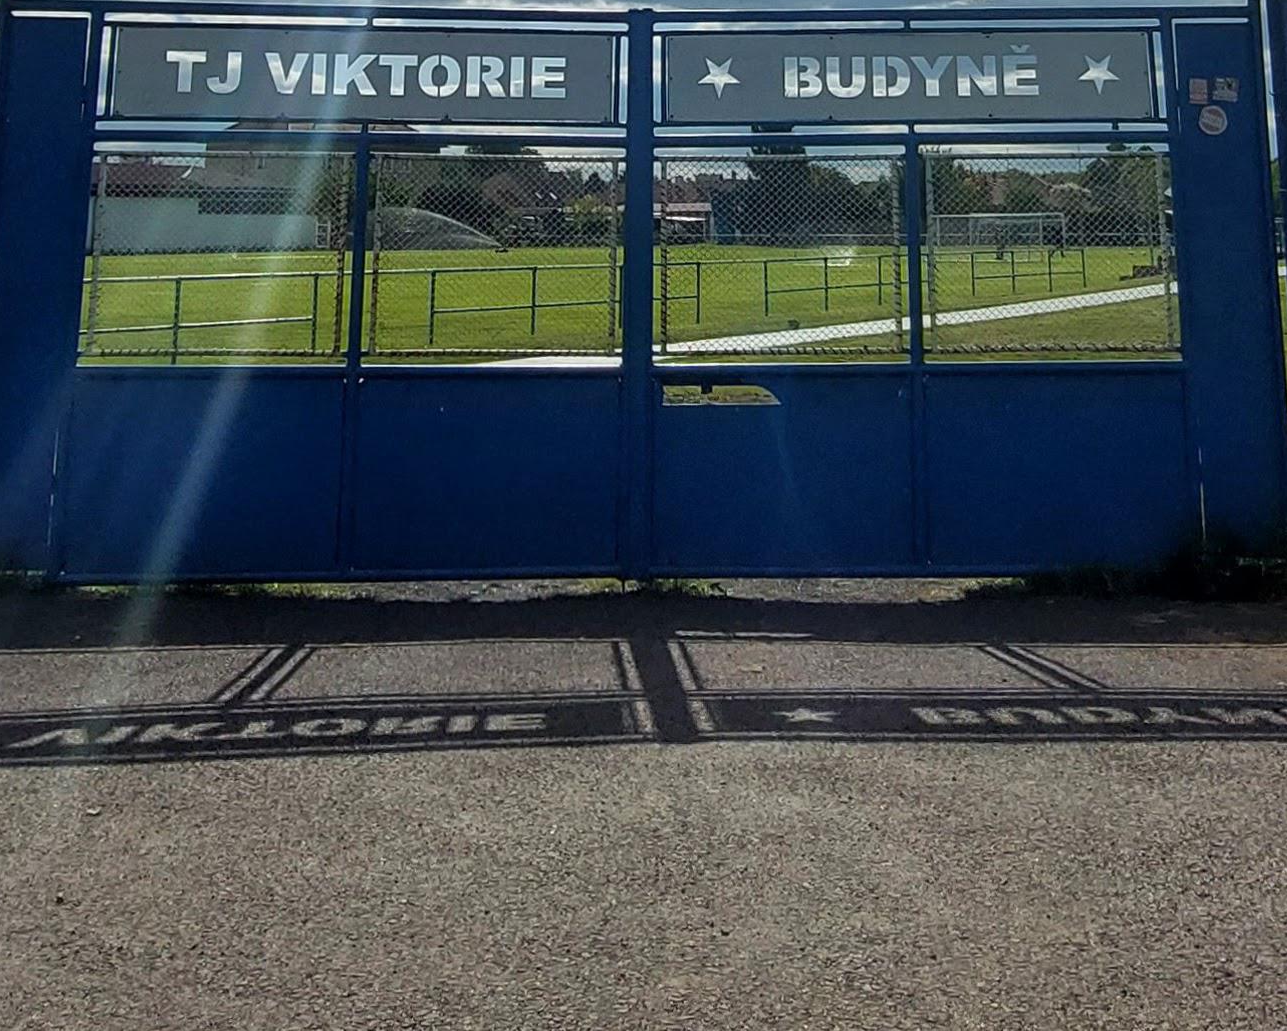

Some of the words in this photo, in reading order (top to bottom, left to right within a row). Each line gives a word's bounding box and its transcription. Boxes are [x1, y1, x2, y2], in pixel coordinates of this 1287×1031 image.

[166, 50, 242, 94] TJ
[266, 52, 567, 99] VIKTORIE
[783, 44, 1040, 98] BUDYNĚ
